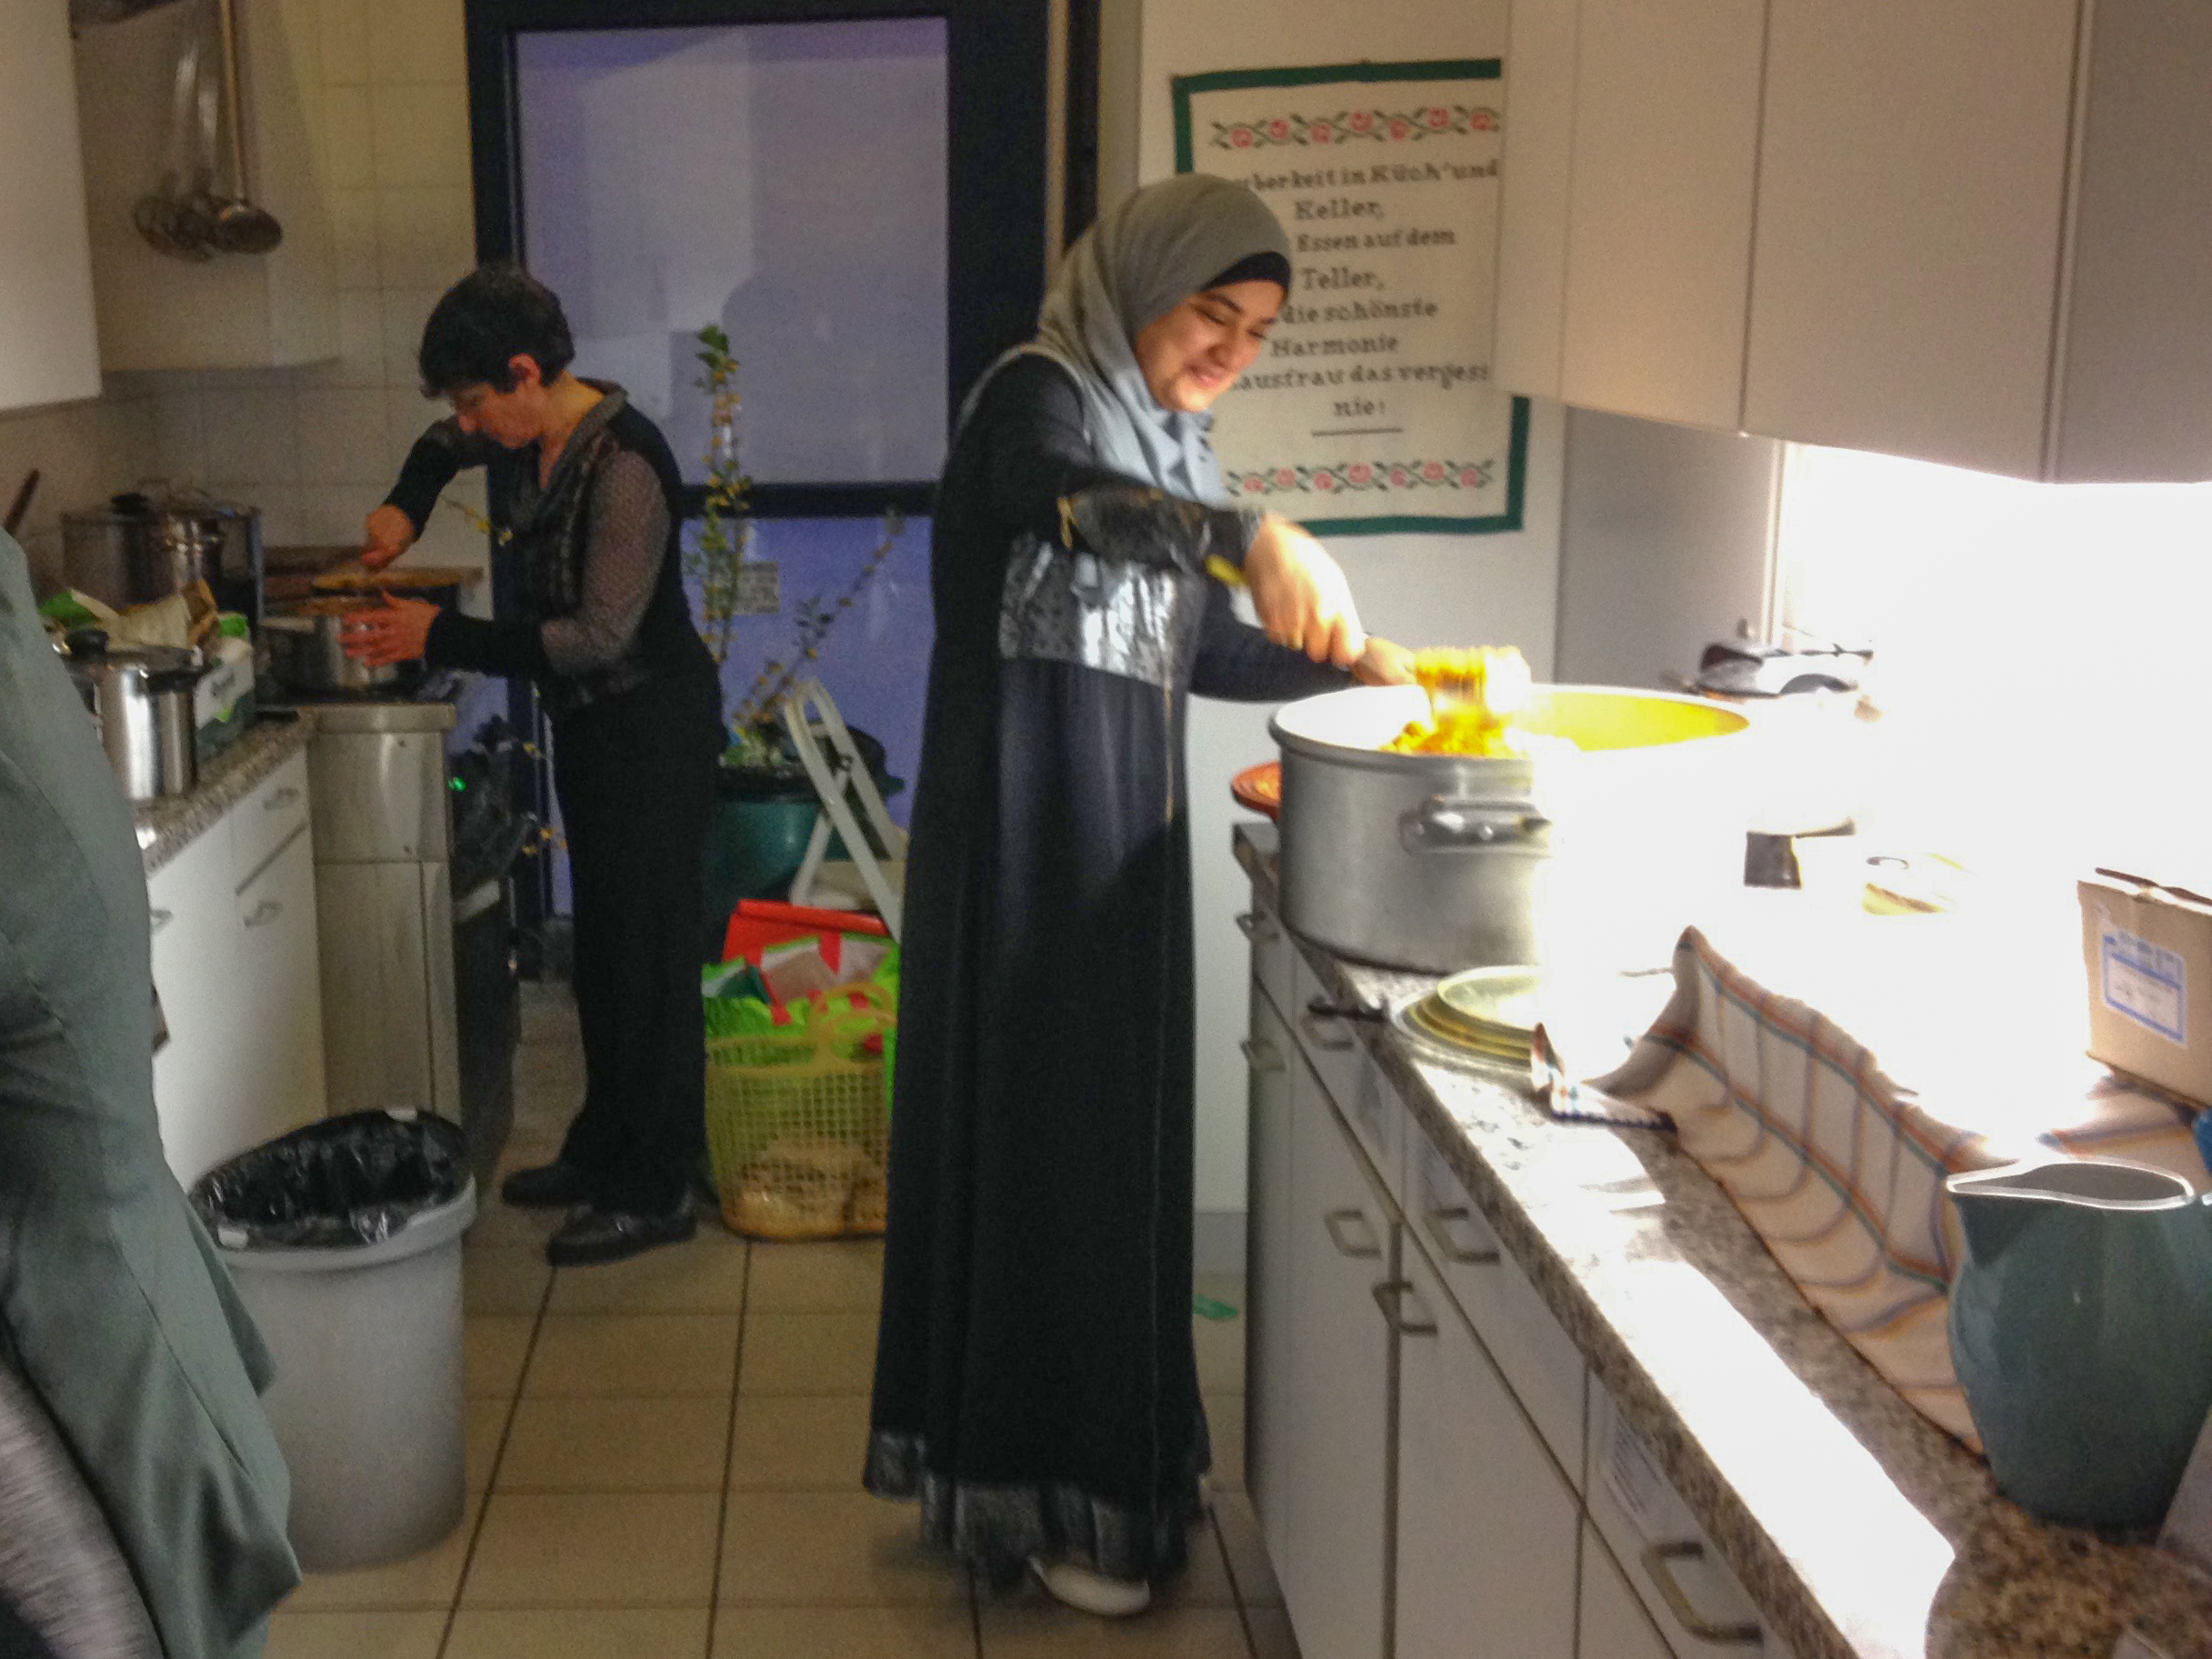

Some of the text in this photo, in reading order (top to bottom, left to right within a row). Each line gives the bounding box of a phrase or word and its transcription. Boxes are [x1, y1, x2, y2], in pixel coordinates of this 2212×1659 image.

[1252, 168, 1336, 191] berkeit
[1295, 197, 1386, 221] Keller,
[1297, 225, 1456, 253] Essen auf dem
[1302, 266, 1386, 292] Teller,
[1271, 333, 1399, 358] Harmonie
[1233, 367, 1346, 392] ausfrau
[1349, 364, 1393, 385] das
